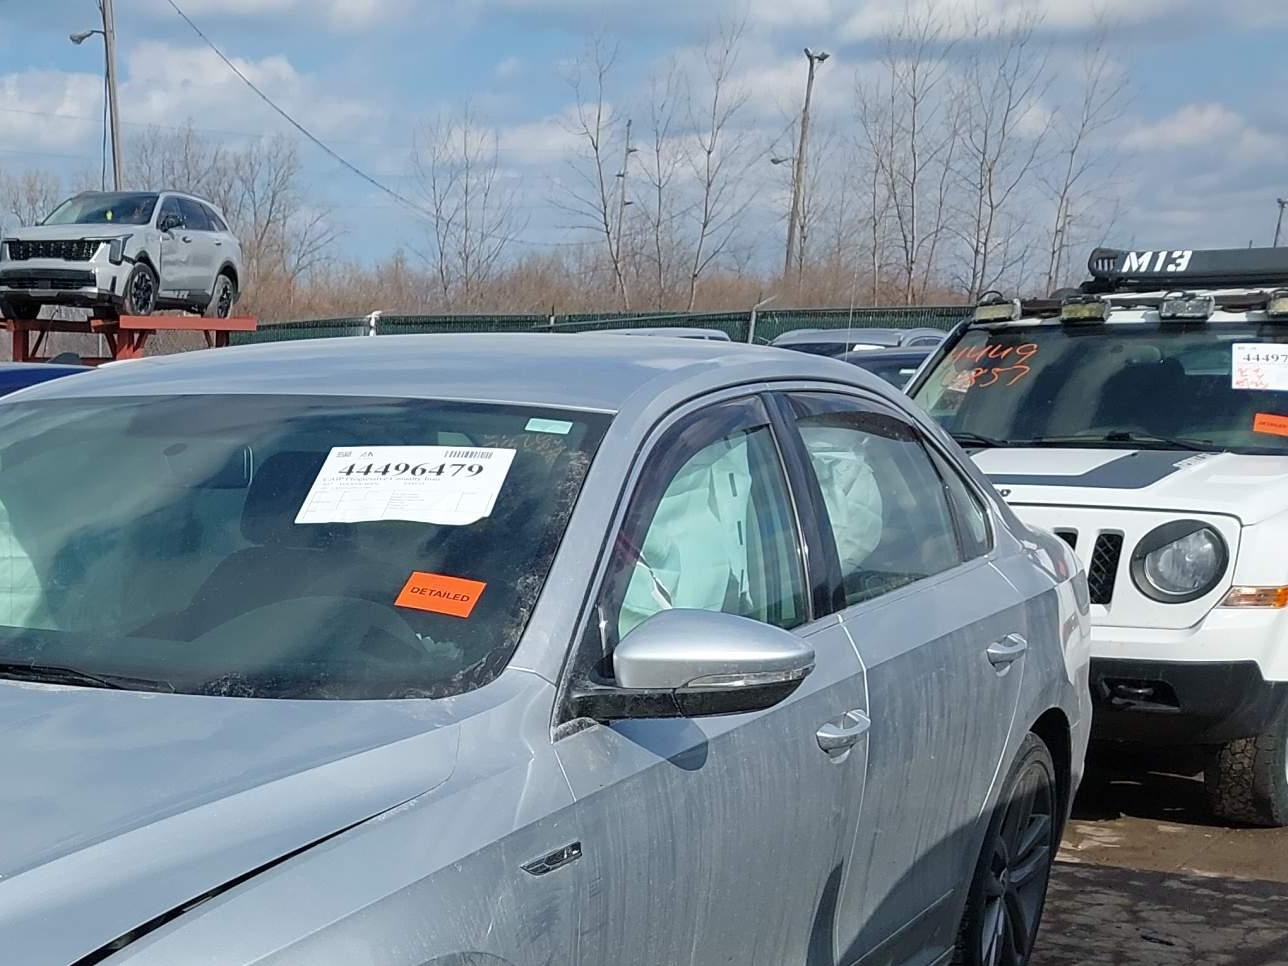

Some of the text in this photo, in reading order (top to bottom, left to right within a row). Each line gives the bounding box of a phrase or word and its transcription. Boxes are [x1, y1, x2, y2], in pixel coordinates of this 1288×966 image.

[1121, 250, 1192, 272] M13
[338, 462, 484, 477] 44496479
[410, 586, 470, 602] DETAILED
